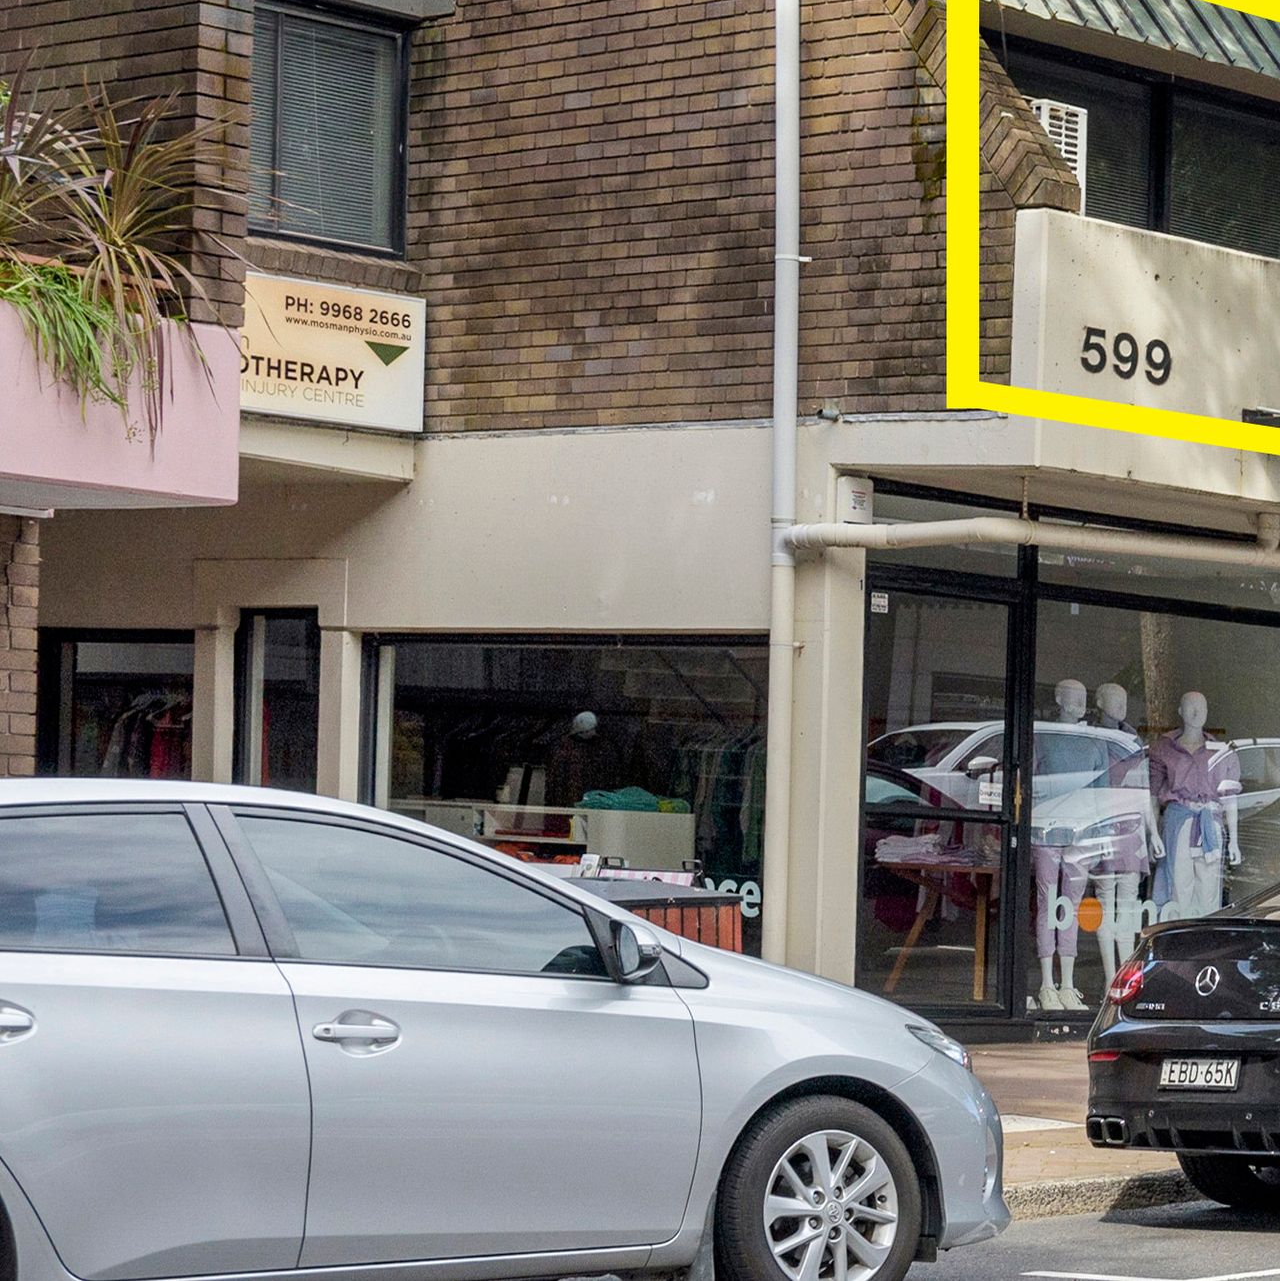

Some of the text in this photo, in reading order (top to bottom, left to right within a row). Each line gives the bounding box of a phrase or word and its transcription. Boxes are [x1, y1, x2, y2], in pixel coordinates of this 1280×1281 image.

[285, 295, 411, 329] PH: 9968 2666
[285, 316, 412, 341] www.mosmanphysio.com.au
[1080, 326, 1172, 386] 599
[241, 378, 365, 408] INJURY CENTRE
